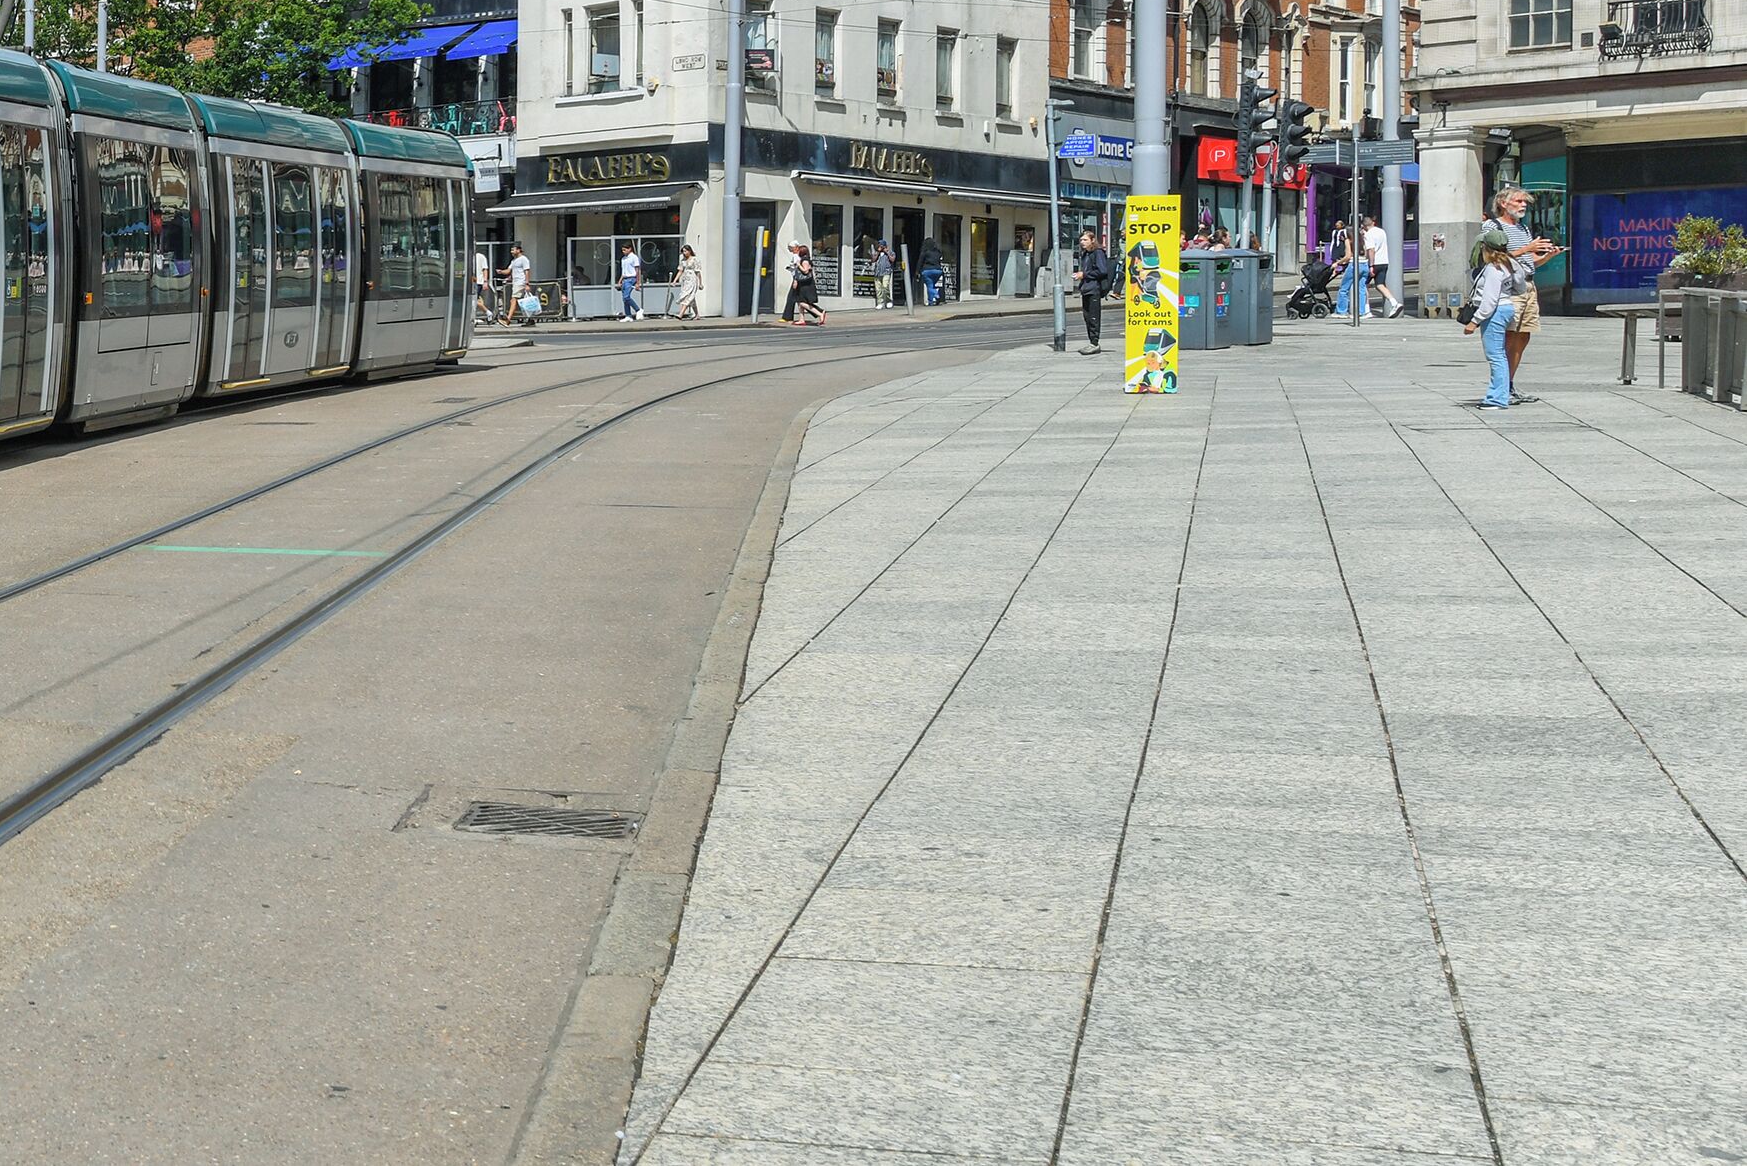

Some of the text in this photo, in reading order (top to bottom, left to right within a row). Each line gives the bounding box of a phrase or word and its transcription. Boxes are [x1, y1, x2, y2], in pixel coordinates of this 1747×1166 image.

[1098, 137, 1124, 157] hone
[1214, 150, 1226, 162] P
[1129, 224, 1171, 234] STOP
[1619, 217, 1686, 232] MAKIN
[1620, 252, 1677, 267] THRI
